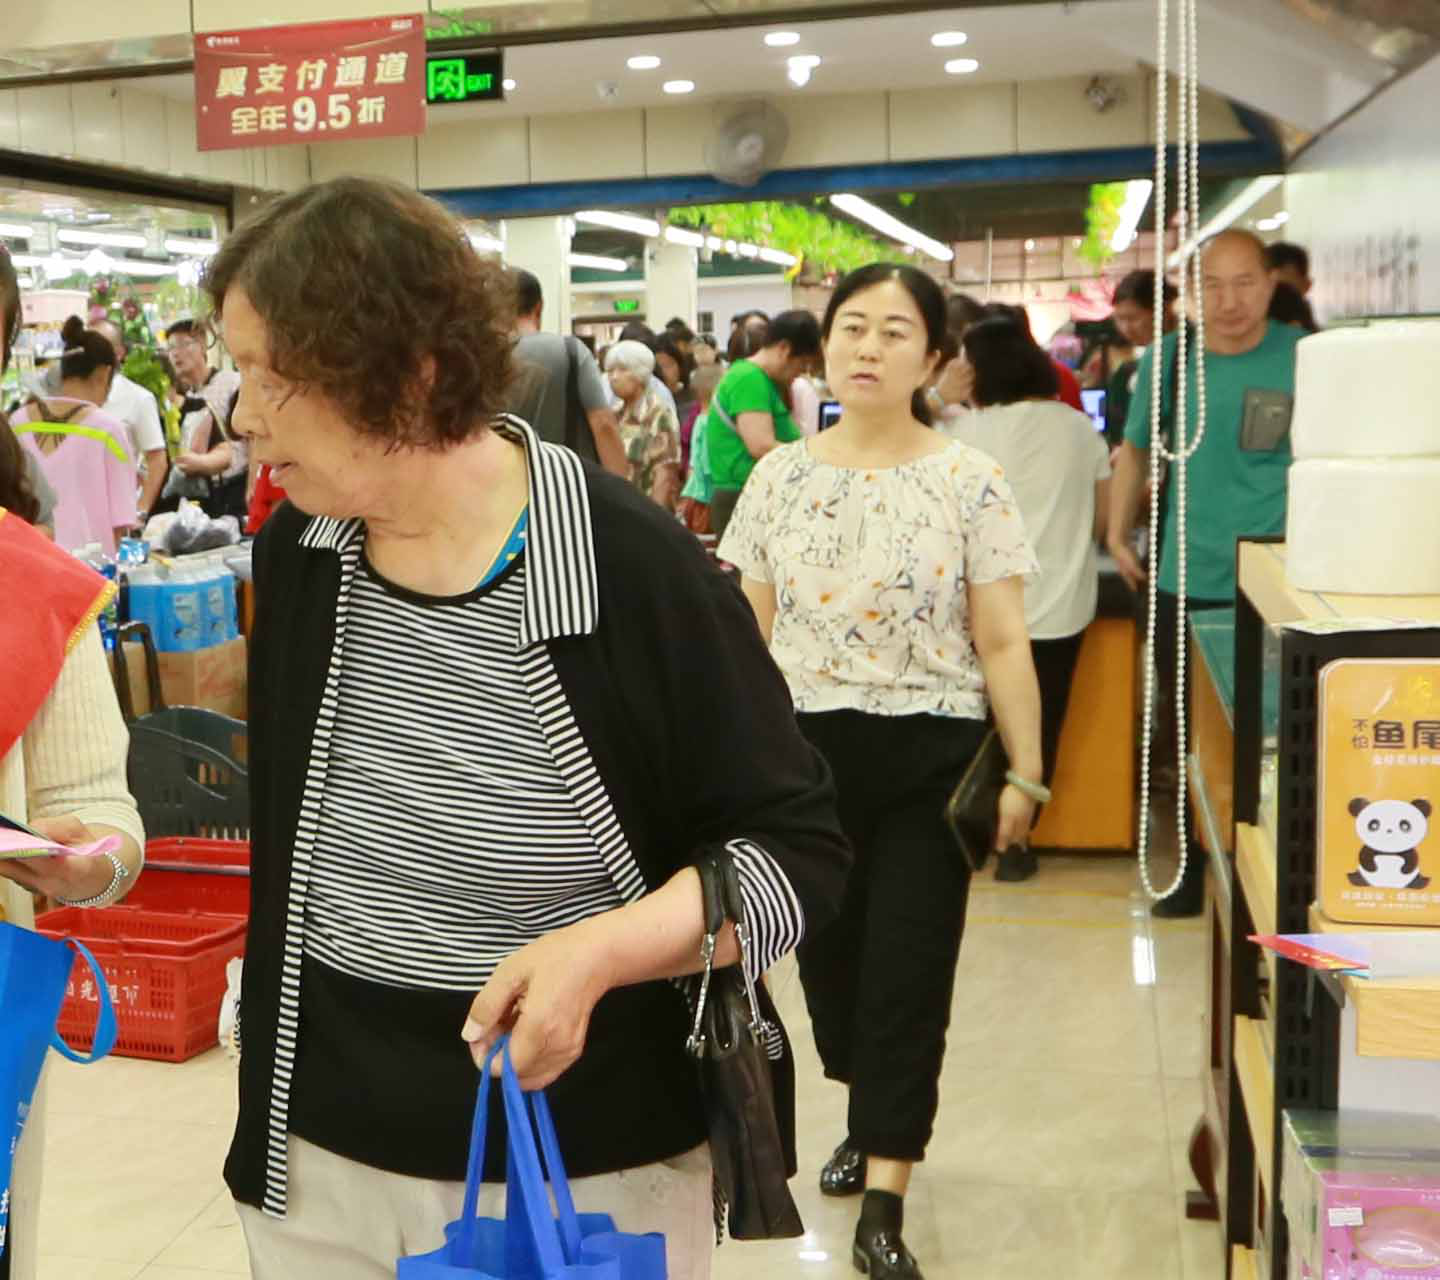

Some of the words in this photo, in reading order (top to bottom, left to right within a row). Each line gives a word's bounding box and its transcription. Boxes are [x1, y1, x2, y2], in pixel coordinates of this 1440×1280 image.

[216, 52, 408, 98] 翼支付通道
